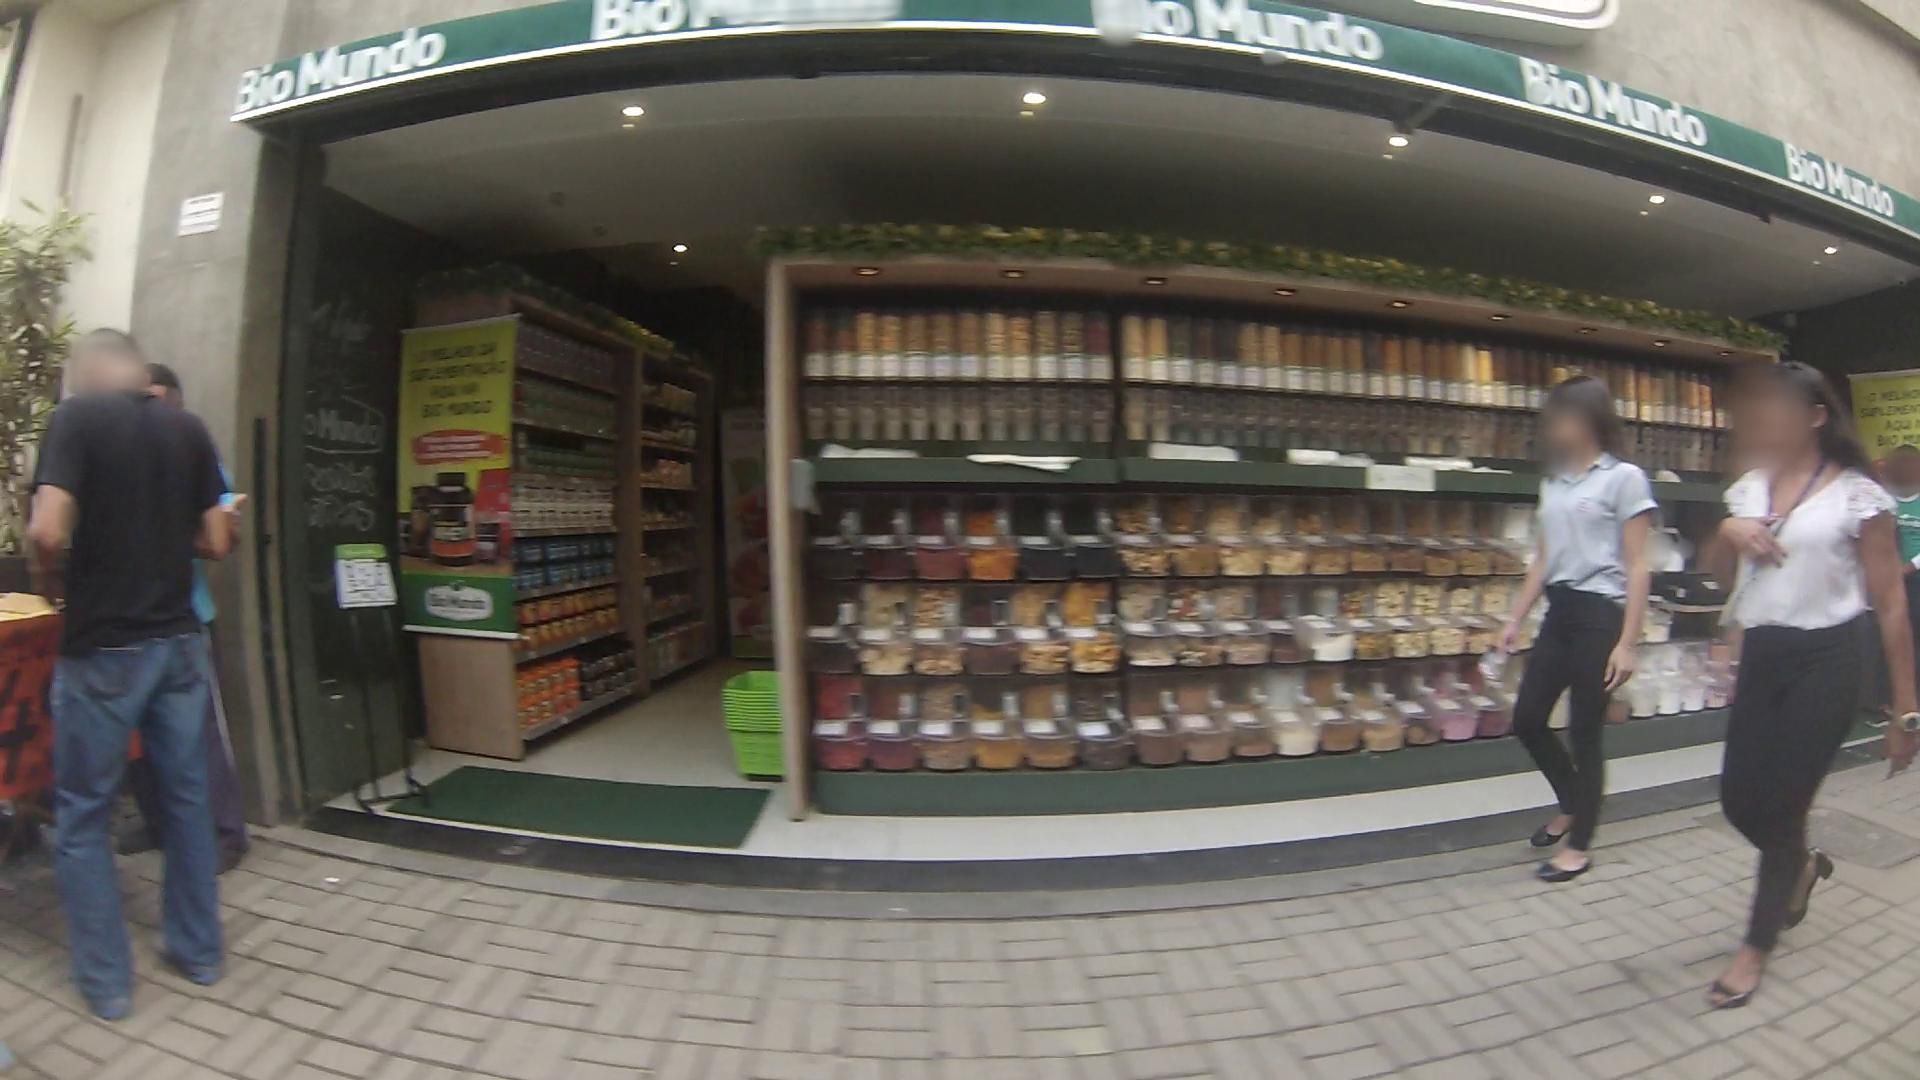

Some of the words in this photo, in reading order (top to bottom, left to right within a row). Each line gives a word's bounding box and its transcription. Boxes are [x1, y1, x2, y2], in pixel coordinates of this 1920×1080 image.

[590, 0, 686, 40] Bio
[1197, 0, 1383, 61] Mundo
[235, 64, 294, 113] Bio
[296, 27, 447, 97] Mundo
[1519, 57, 1591, 117] Bio
[1587, 75, 1708, 147] Mundo
[1784, 143, 1825, 189] Bio
[1825, 160, 1895, 218] Mundo
